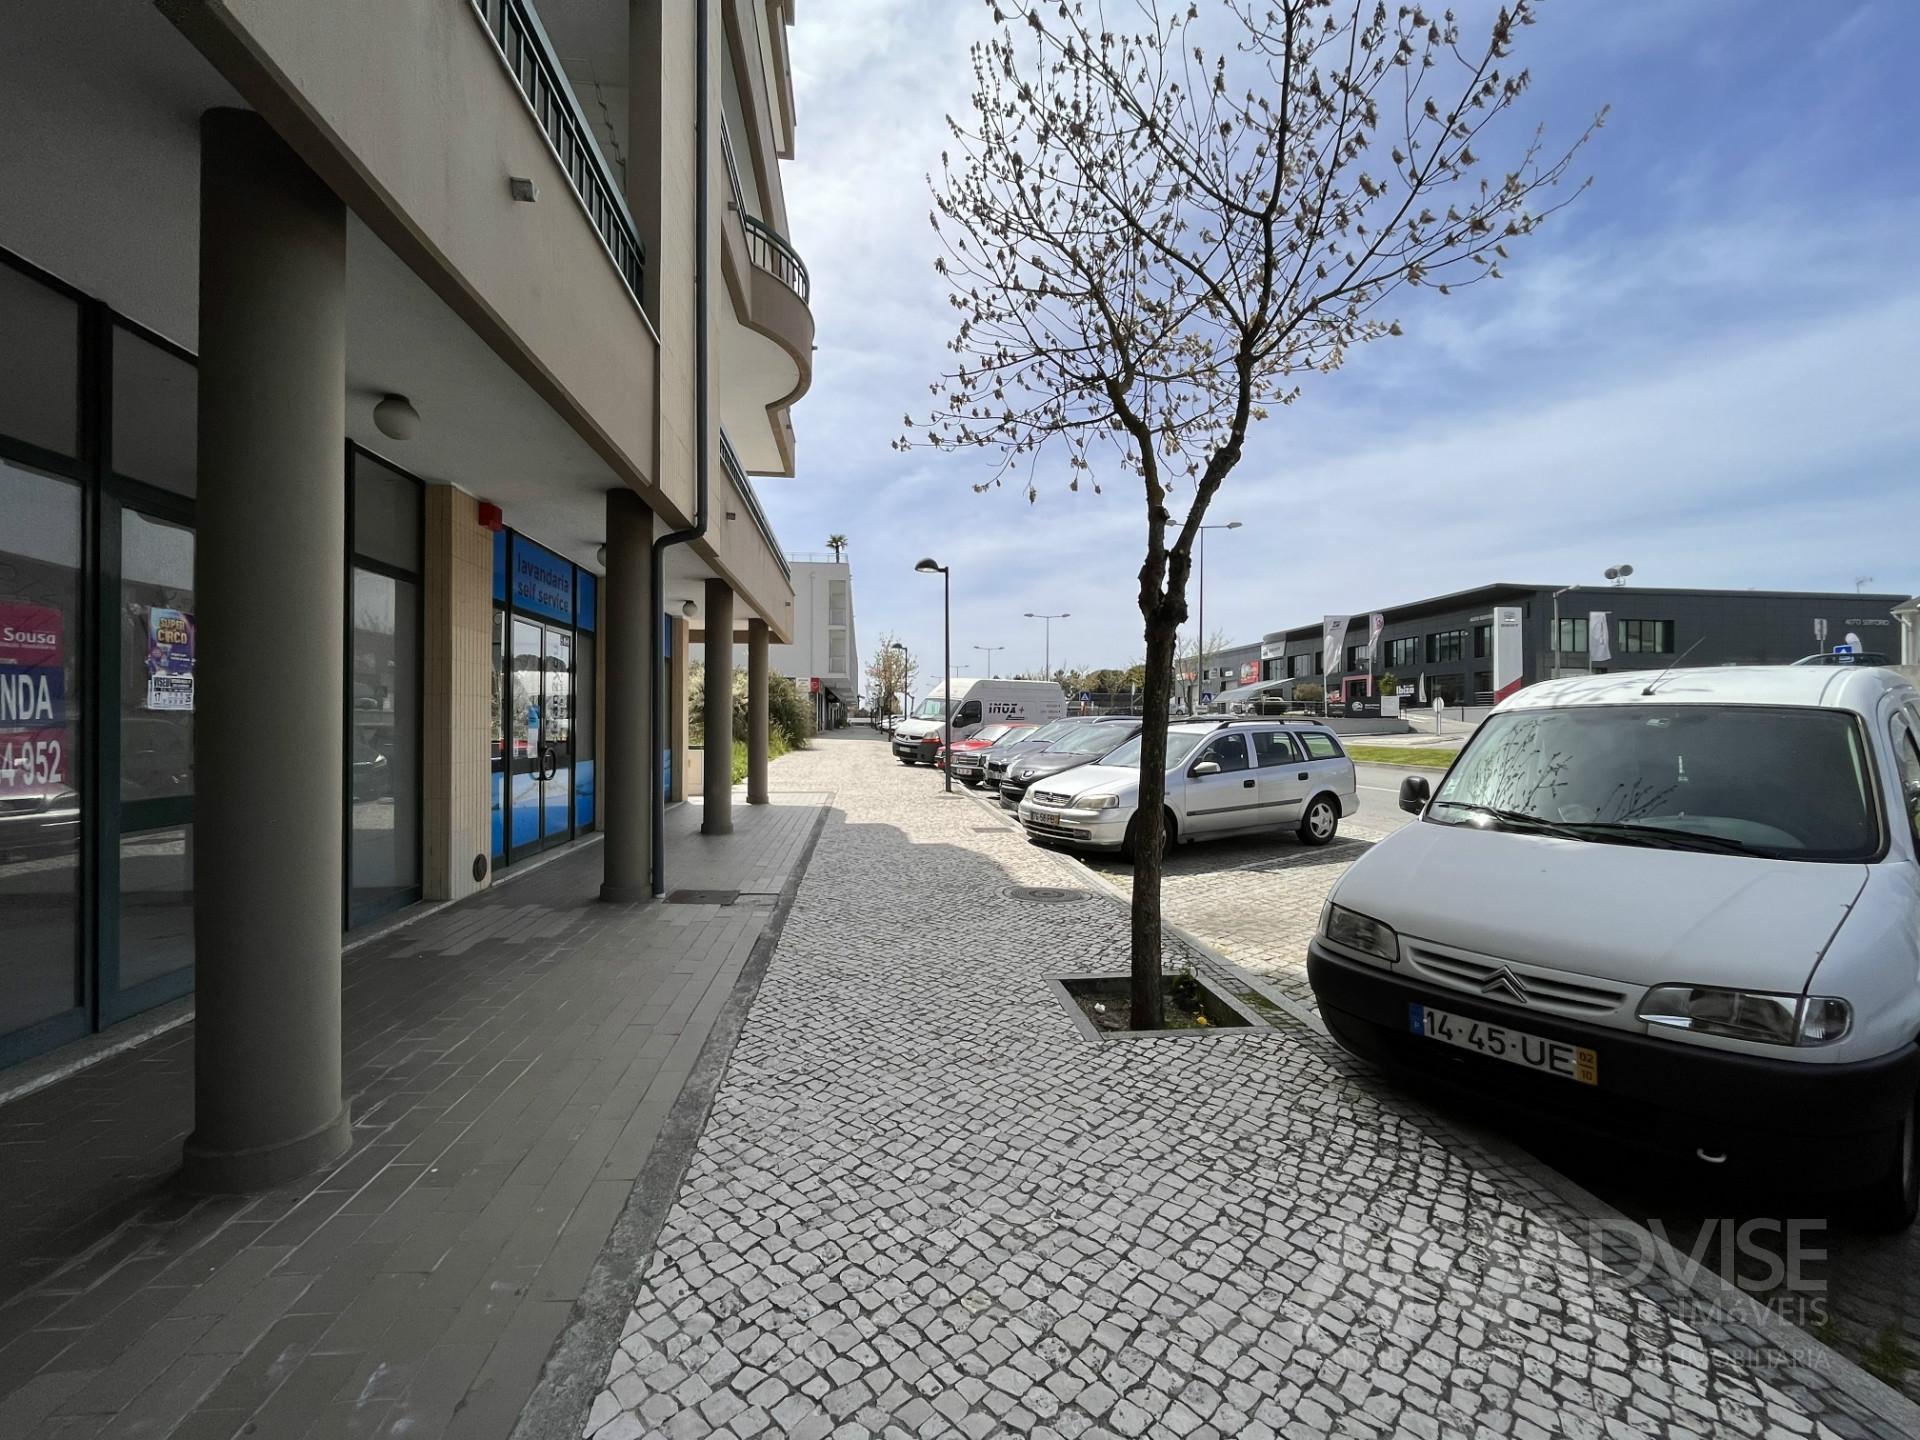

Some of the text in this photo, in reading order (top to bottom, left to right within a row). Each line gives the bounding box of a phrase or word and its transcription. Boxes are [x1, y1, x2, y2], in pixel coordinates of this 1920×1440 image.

[518, 552, 569, 593] lavandaria
[518, 581, 569, 612] self service
[3, 627, 56, 645] Sousa
[161, 618, 185, 630] SUPER
[158, 630, 187, 644] CIRCO
[0, 673, 53, 722] NDA
